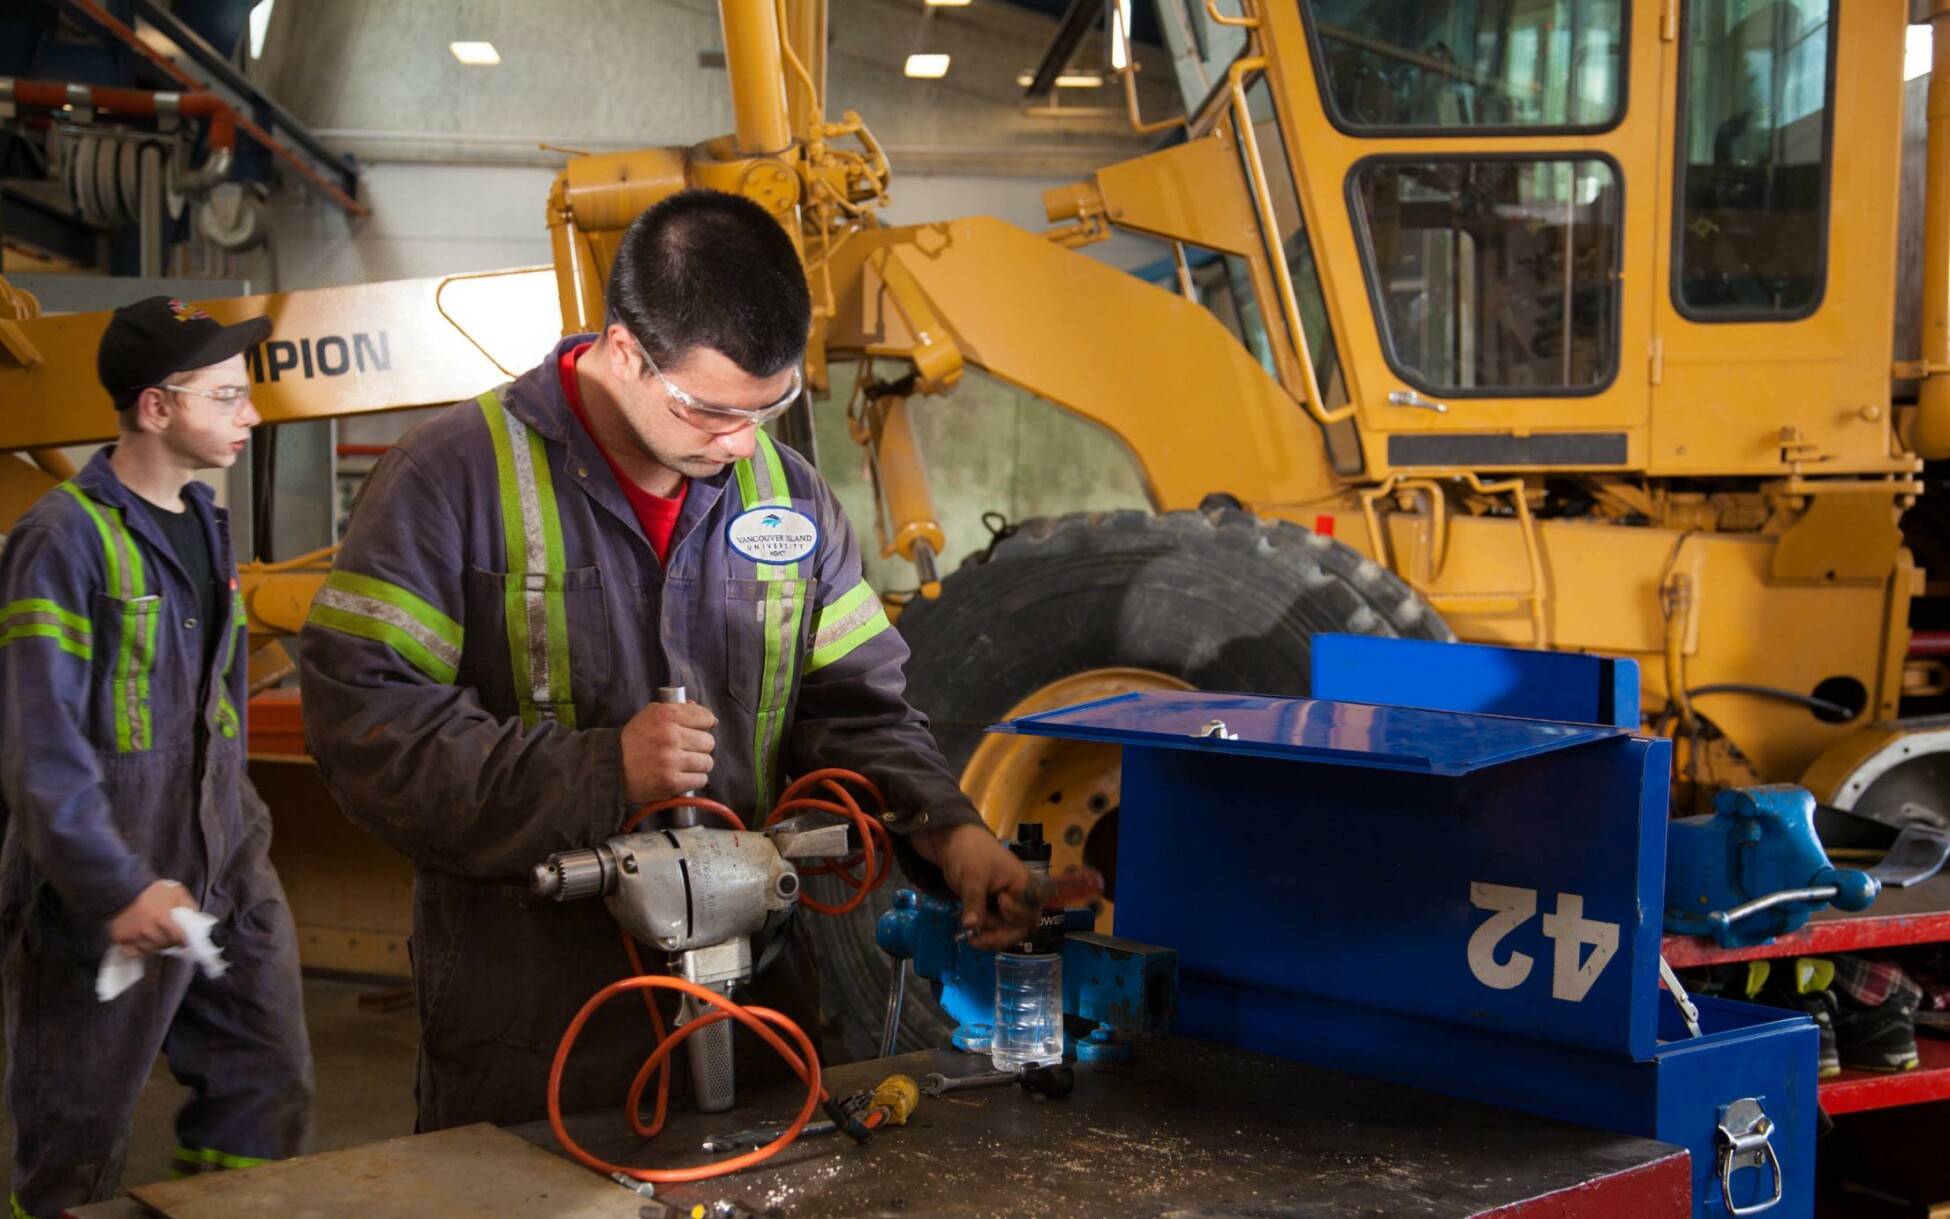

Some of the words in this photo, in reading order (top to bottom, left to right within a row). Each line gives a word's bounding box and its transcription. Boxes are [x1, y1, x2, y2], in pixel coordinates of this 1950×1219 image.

[736, 534, 784, 543] VANCOUVER
[785, 534, 813, 543] ISLAND
[747, 543, 804, 551] UNIVERSITY
[1467, 881, 1620, 1002] 42
